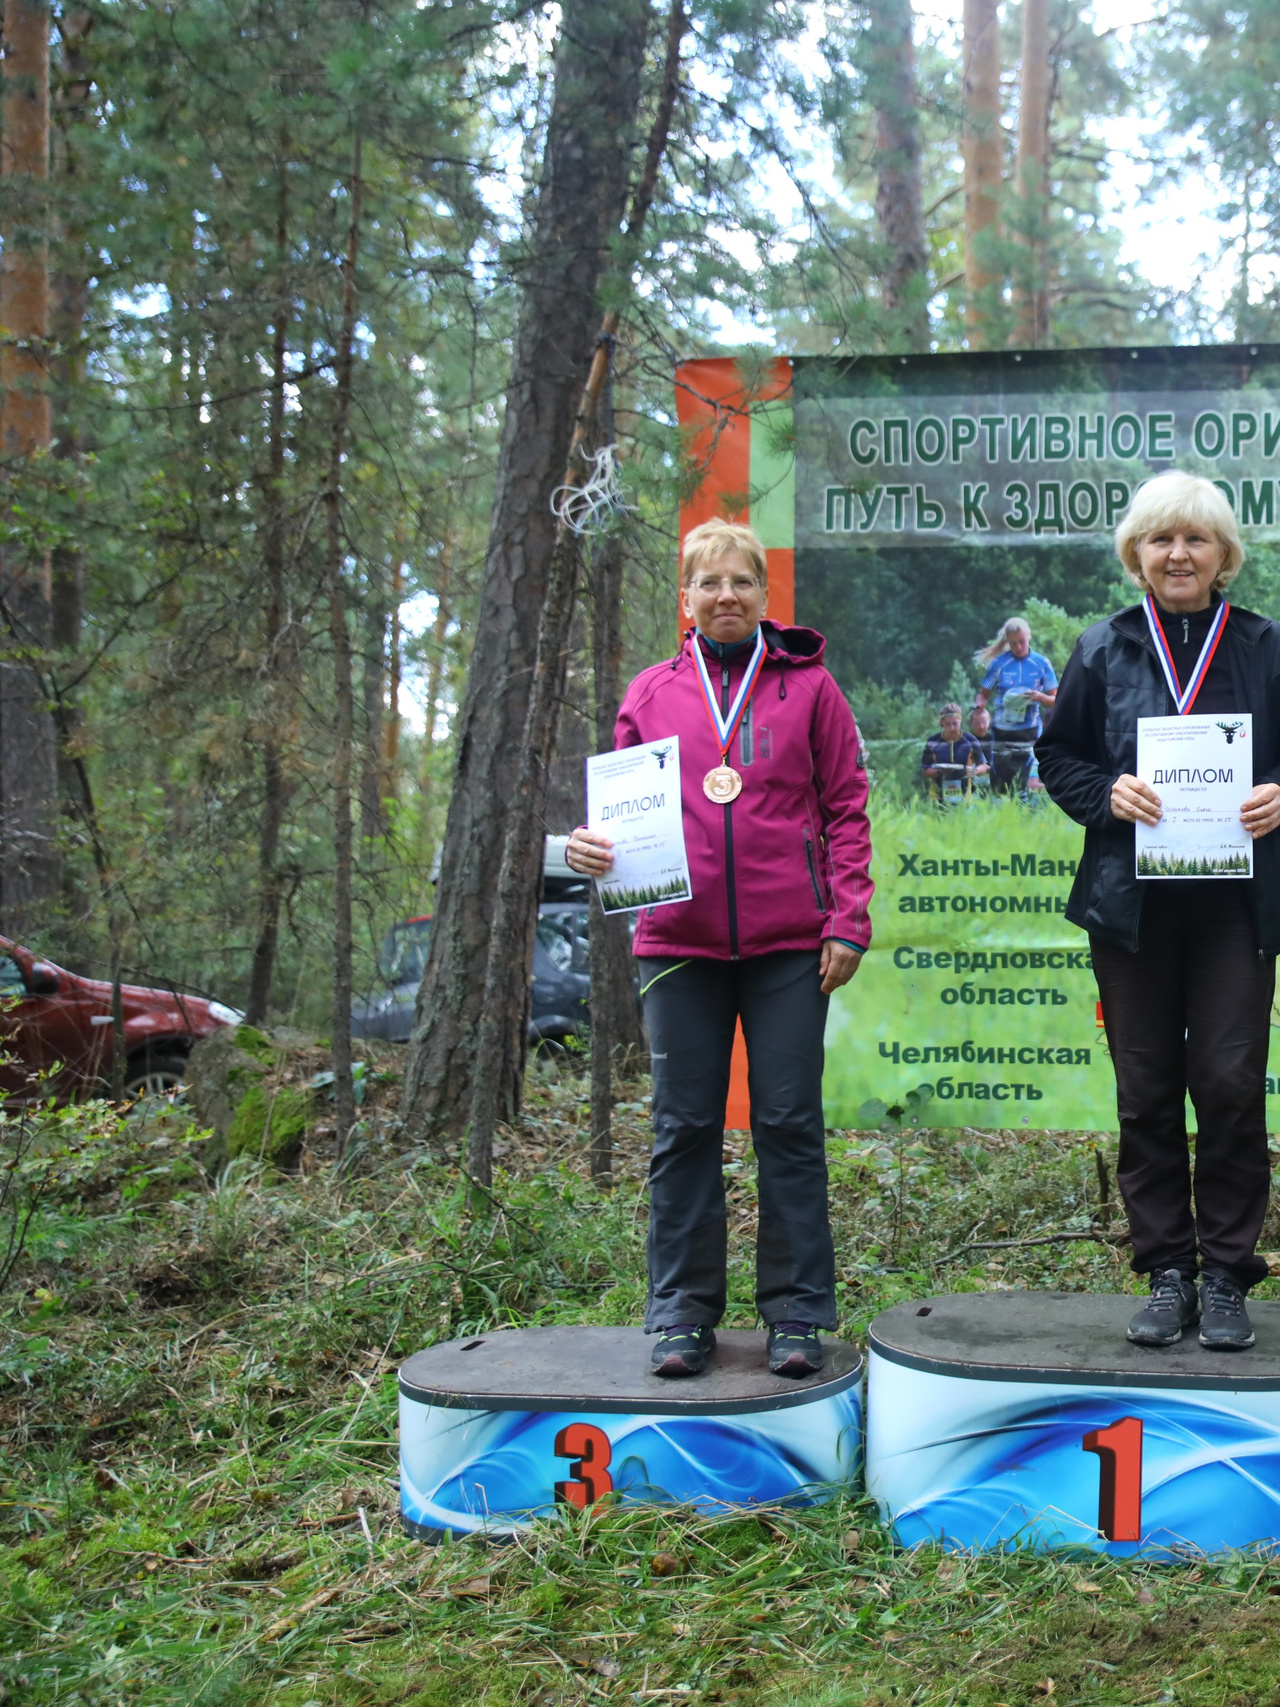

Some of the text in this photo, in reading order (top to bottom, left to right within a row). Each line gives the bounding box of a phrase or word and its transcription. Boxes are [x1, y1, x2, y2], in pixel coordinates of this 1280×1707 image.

[849, 413, 1175, 465] СПОРТИВНОЕ
[825, 485, 945, 531] ПУТЬ
[963, 483, 989, 530] К
[1152, 768, 1234, 785] ДИПЛОМ
[601, 793, 666, 821] ДИПЛОМ
[898, 854, 1077, 876] Ханты-Ман
[941, 982, 1068, 1006] область
[878, 1041, 1091, 1066] Челябинская
[554, 1422, 613, 1518] 3
[1082, 1415, 1143, 1542] 1
